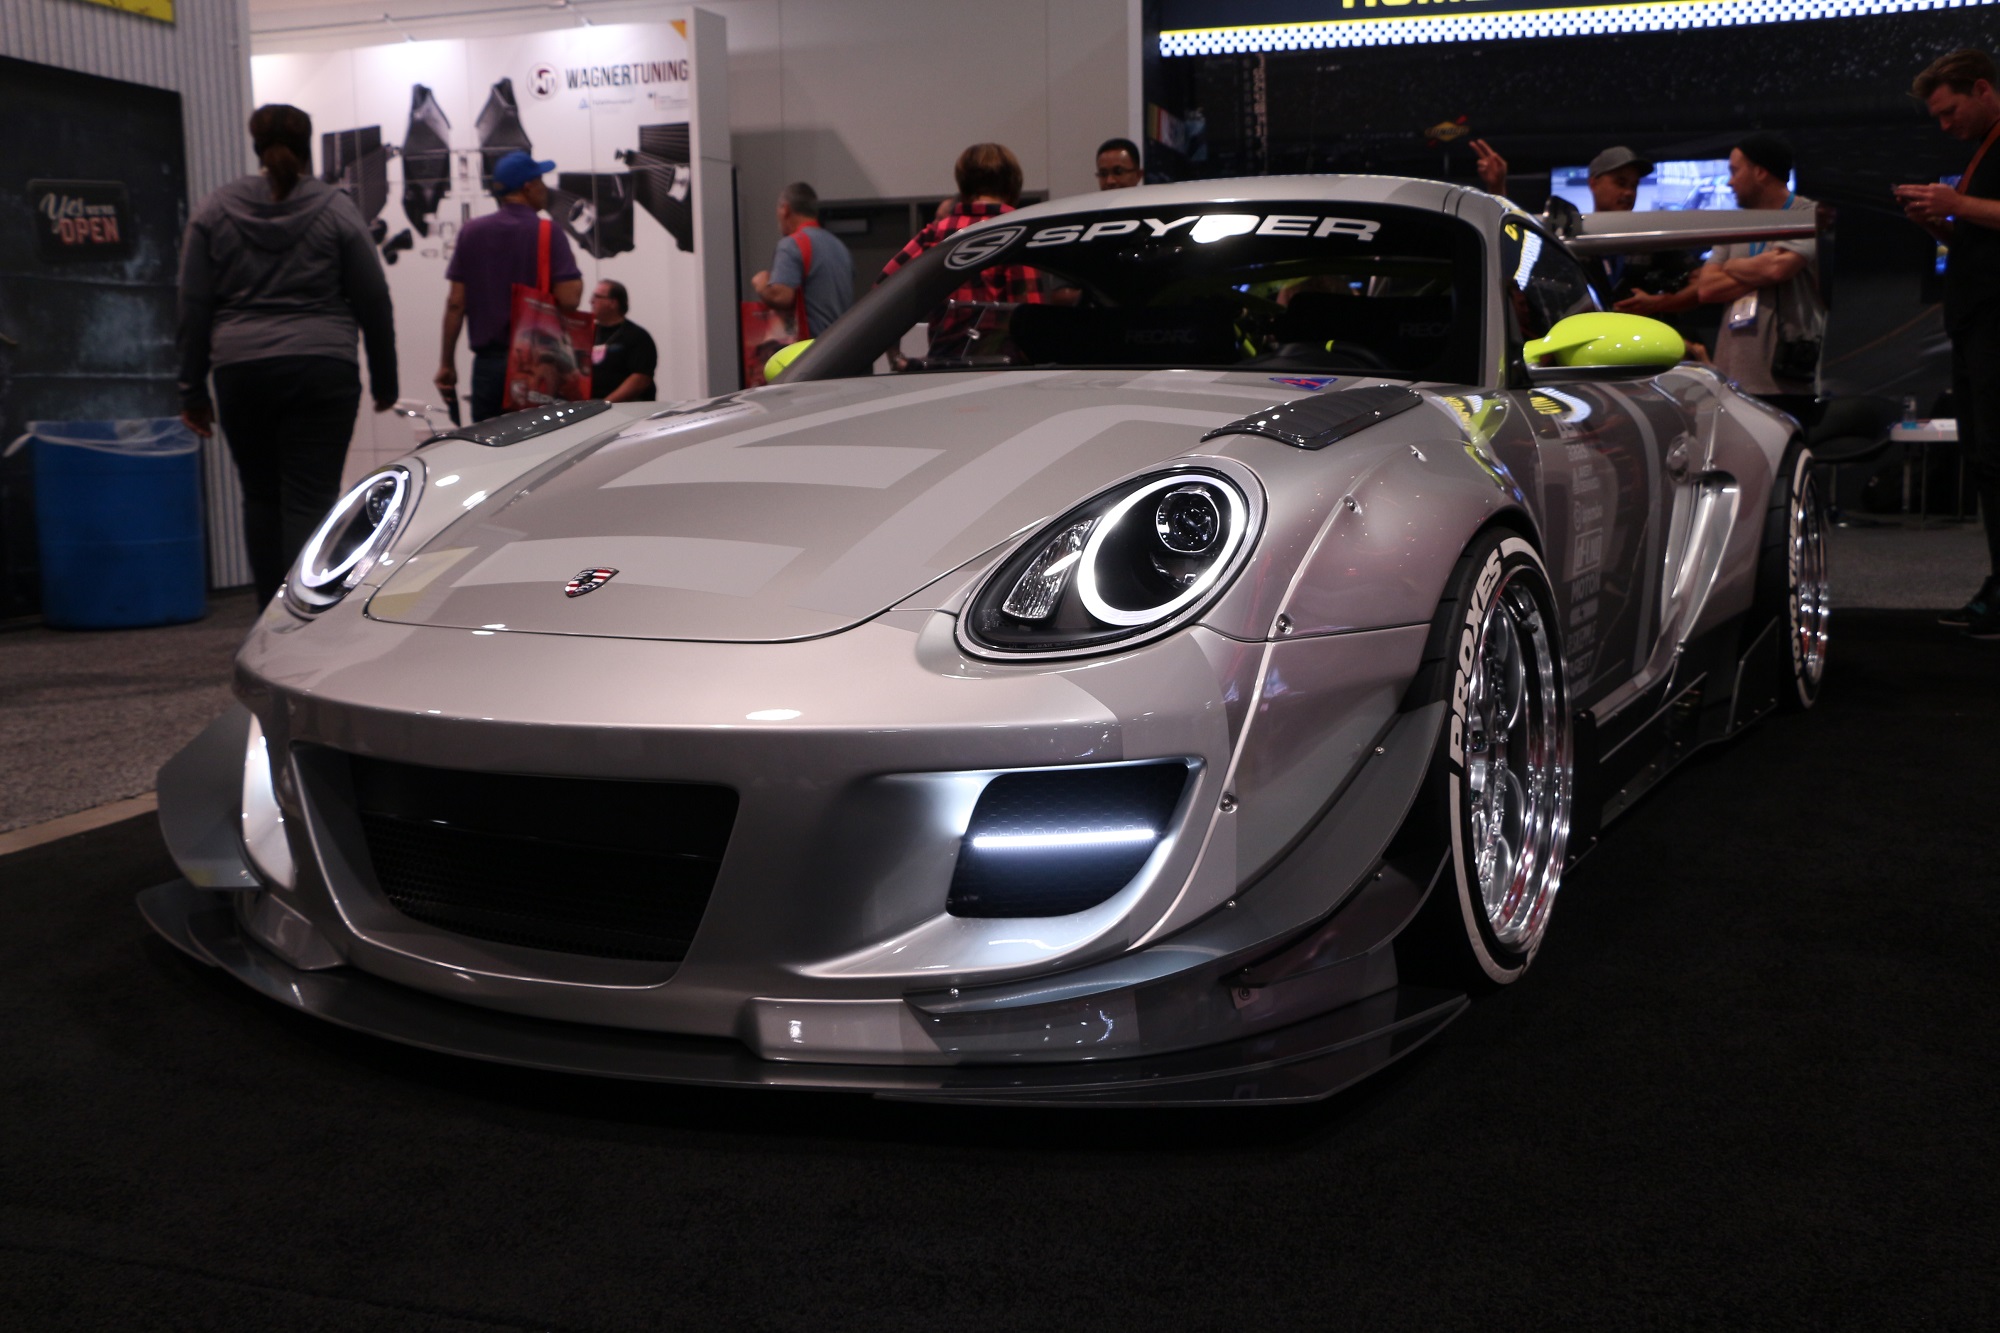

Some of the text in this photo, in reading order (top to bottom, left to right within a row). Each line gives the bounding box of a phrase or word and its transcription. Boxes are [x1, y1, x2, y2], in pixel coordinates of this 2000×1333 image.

[565, 60, 689, 89] WAGNERTUNING
[59, 217, 120, 244] OPEN
[1025, 213, 1382, 249] SPYDER
[1449, 547, 1502, 768] PROXES
